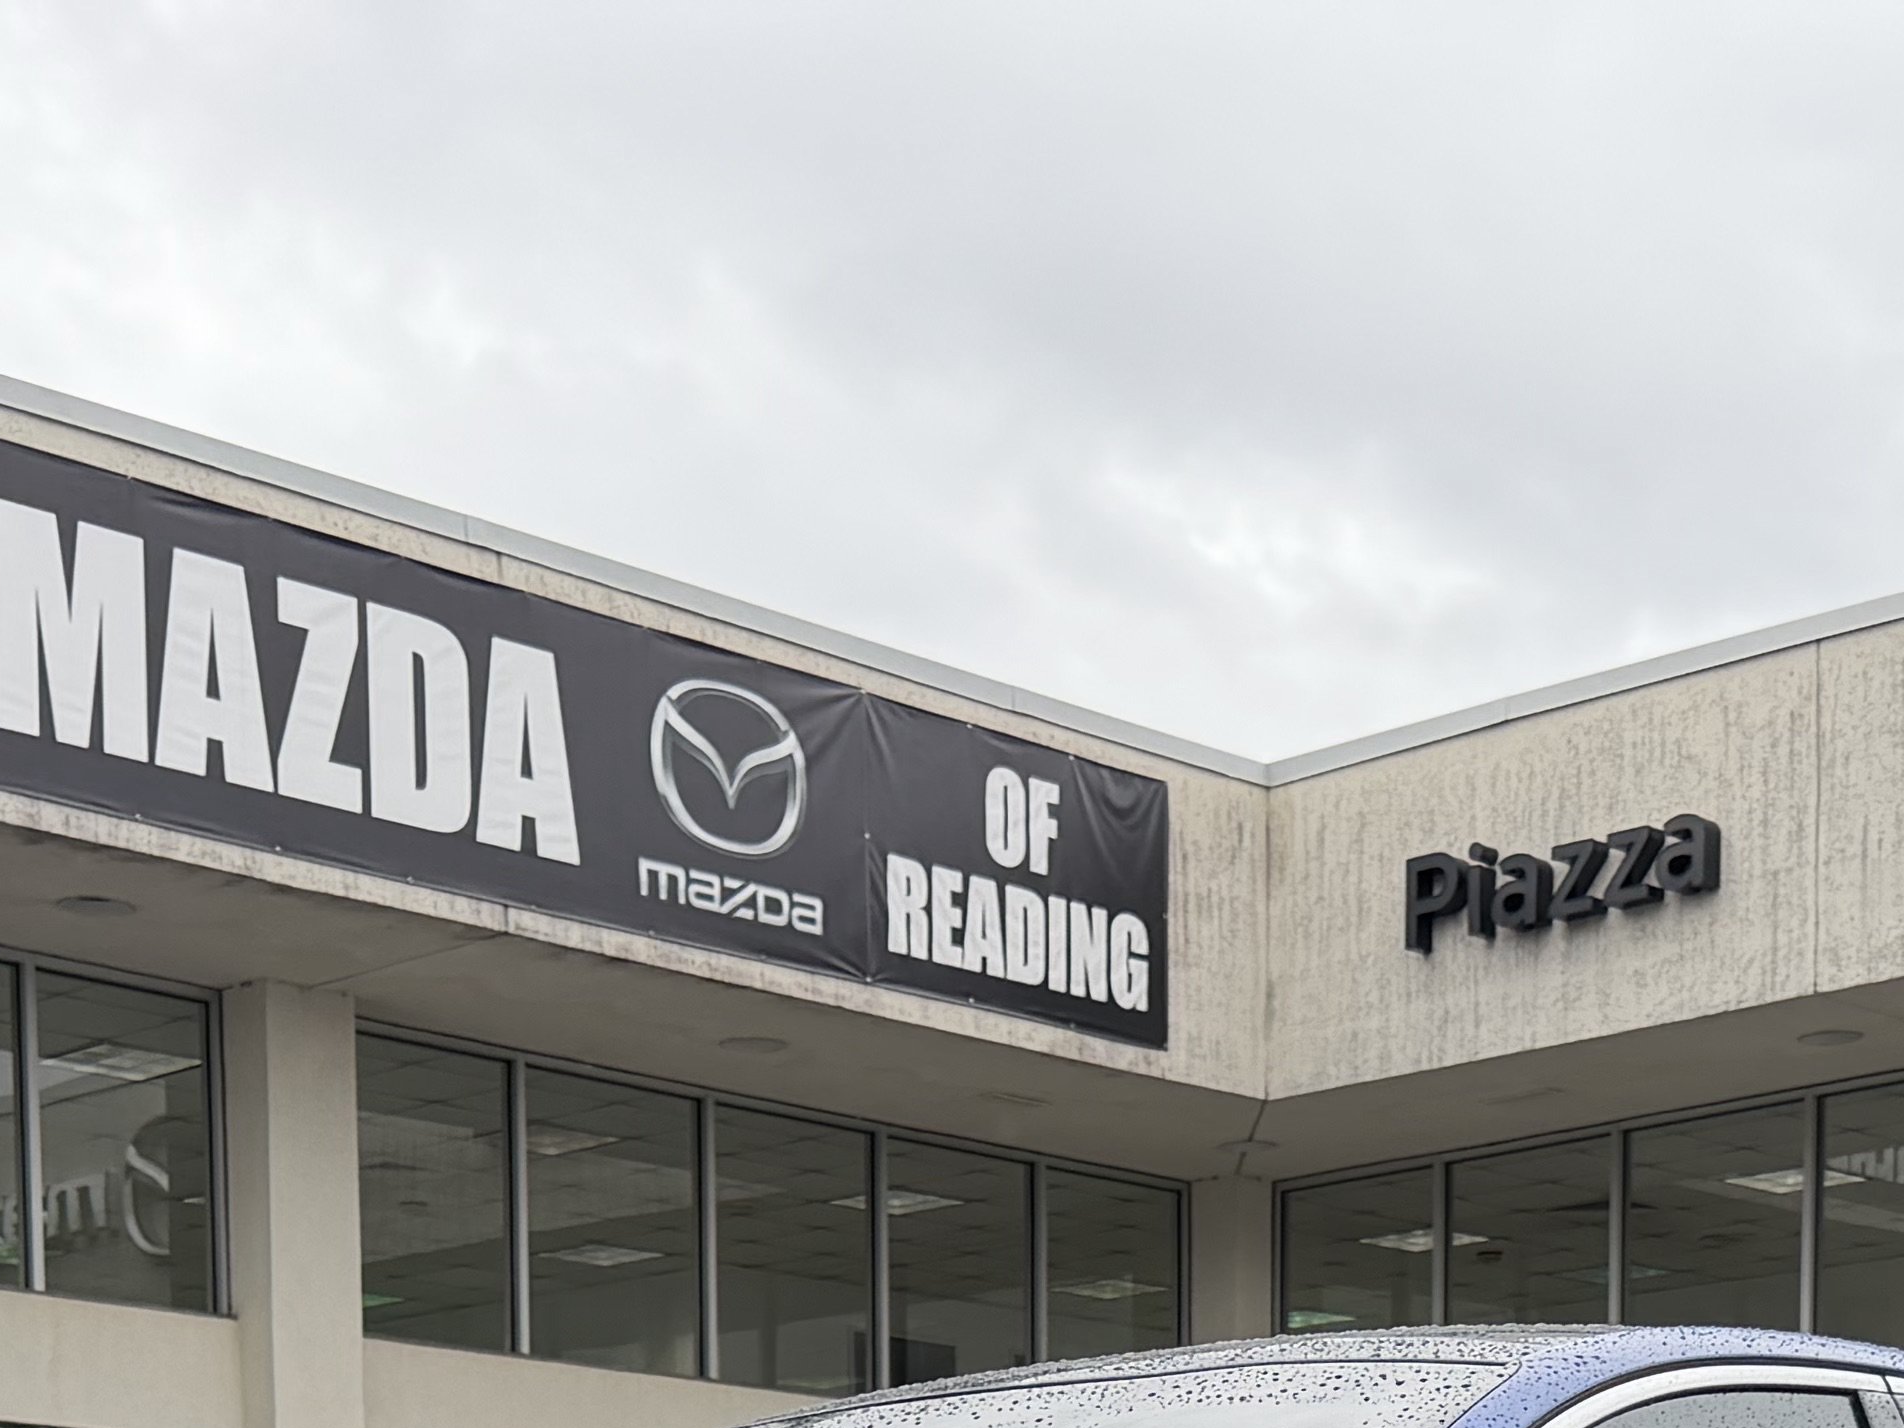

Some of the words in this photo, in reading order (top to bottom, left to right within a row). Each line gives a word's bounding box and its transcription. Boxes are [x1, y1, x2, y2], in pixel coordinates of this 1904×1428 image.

[983, 765, 1062, 876] OF
[637, 857, 825, 936] mazda
[884, 852, 1151, 1013] READING
[1404, 813, 1722, 955] Piazza
